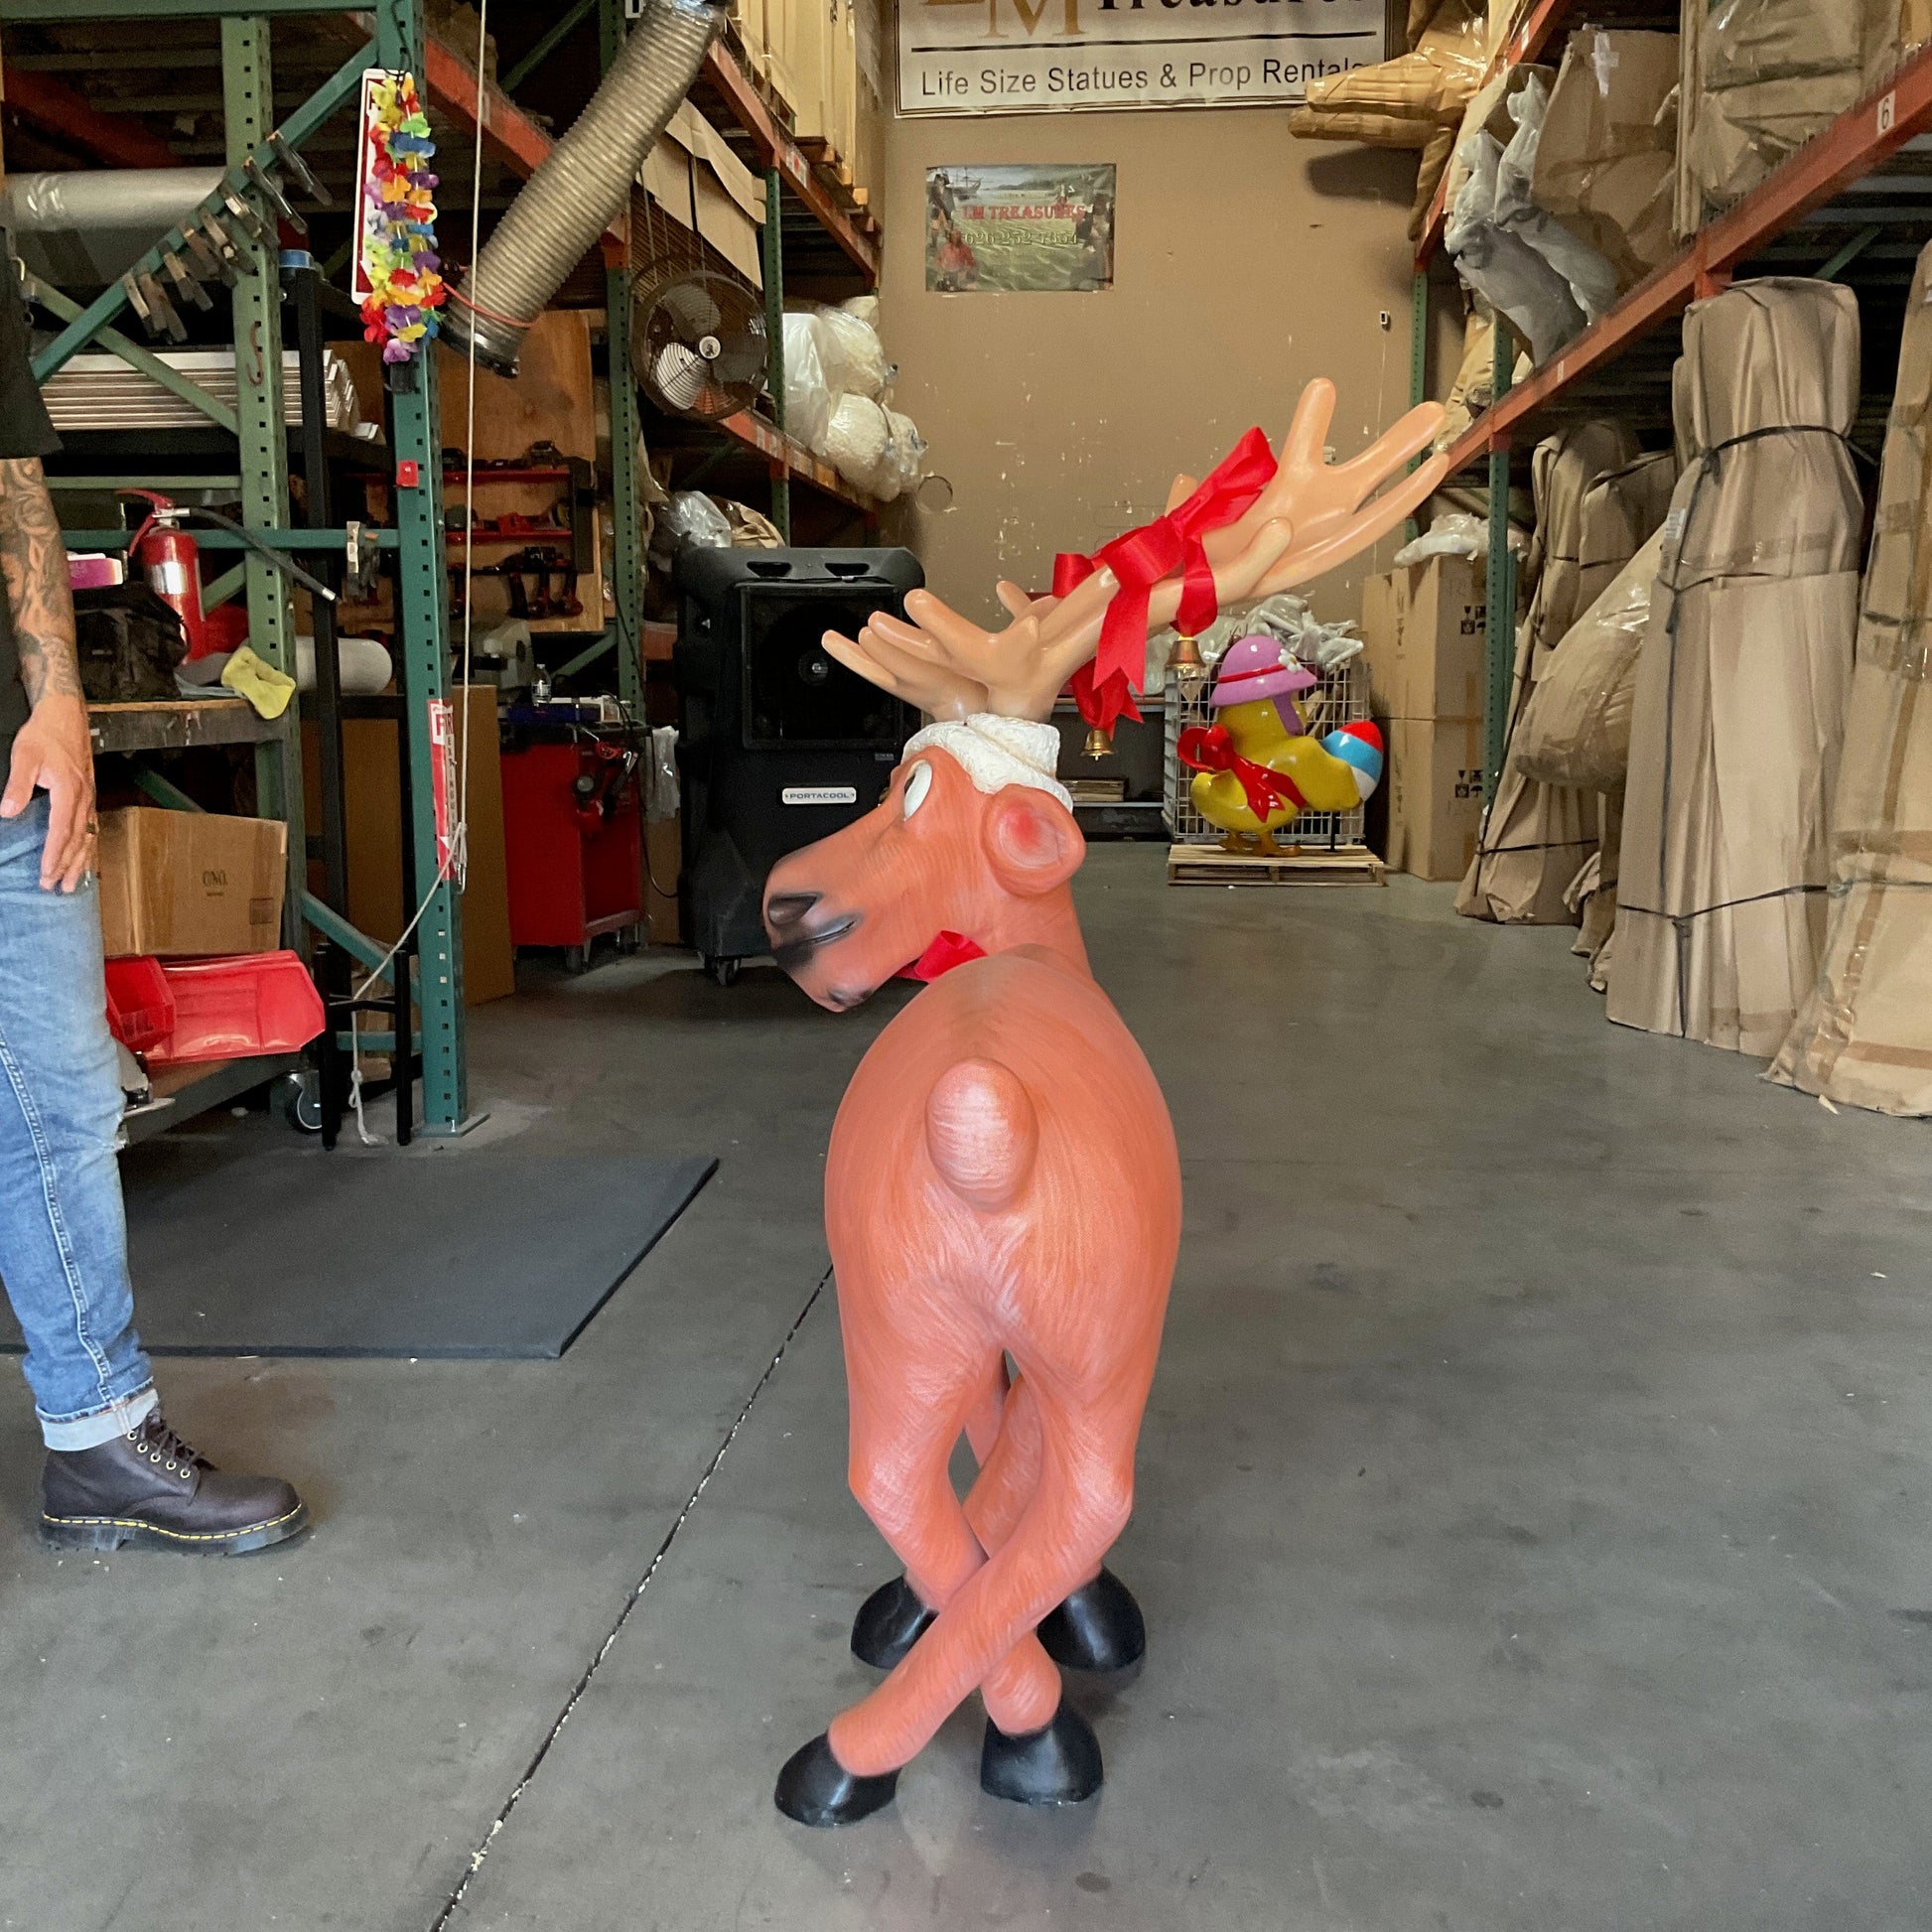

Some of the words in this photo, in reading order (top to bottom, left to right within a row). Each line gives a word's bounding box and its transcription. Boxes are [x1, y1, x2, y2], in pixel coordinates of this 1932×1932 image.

[922, 70, 969, 95] Life
[980, 69, 1036, 94] Size
[1047, 66, 1148, 92] Statues
[1160, 64, 1177, 88] &
[1189, 63, 1251, 90] Prop
[1263, 58, 1365, 83] Rental
[1881, 97, 1890, 130] 6
[989, 204, 1086, 220] TREASURES
[964, 231, 995, 244] 626
[1001, 231, 1033, 245] 252
